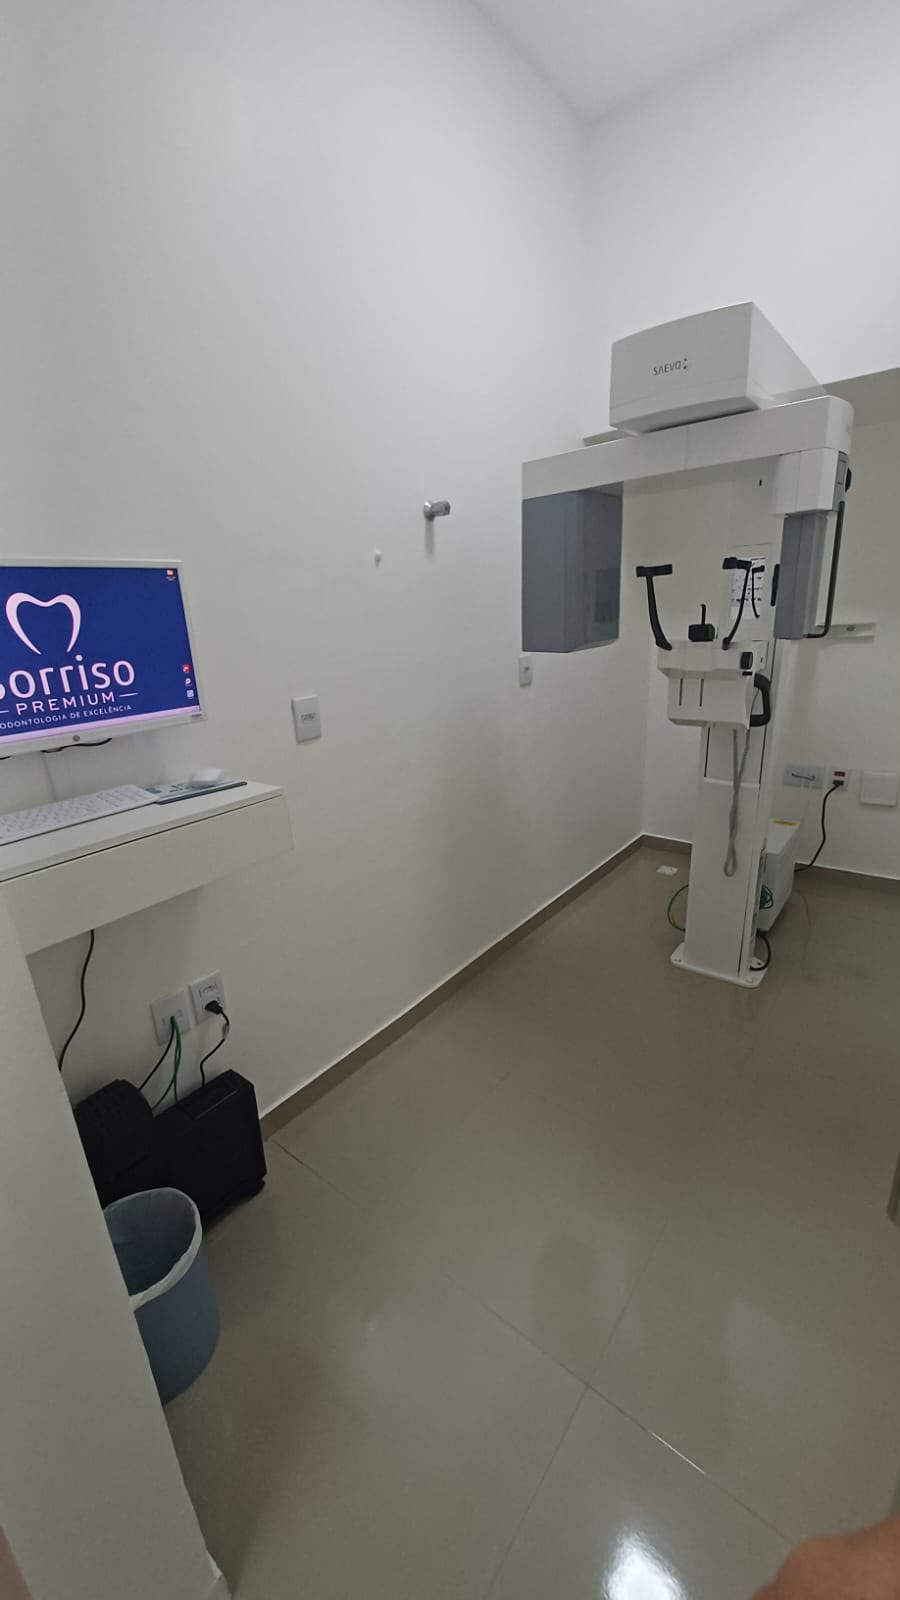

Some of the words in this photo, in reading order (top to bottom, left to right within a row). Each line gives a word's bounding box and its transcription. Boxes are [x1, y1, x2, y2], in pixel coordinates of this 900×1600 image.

[653, 360, 681, 376] SAEVO
[16, 691, 115, 715] PREMIUM
[0, 714, 67, 729] ODONTOLOGIA
[70, 711, 81, 719] DE
[83, 705, 132, 717] EXCELÊNCIA
